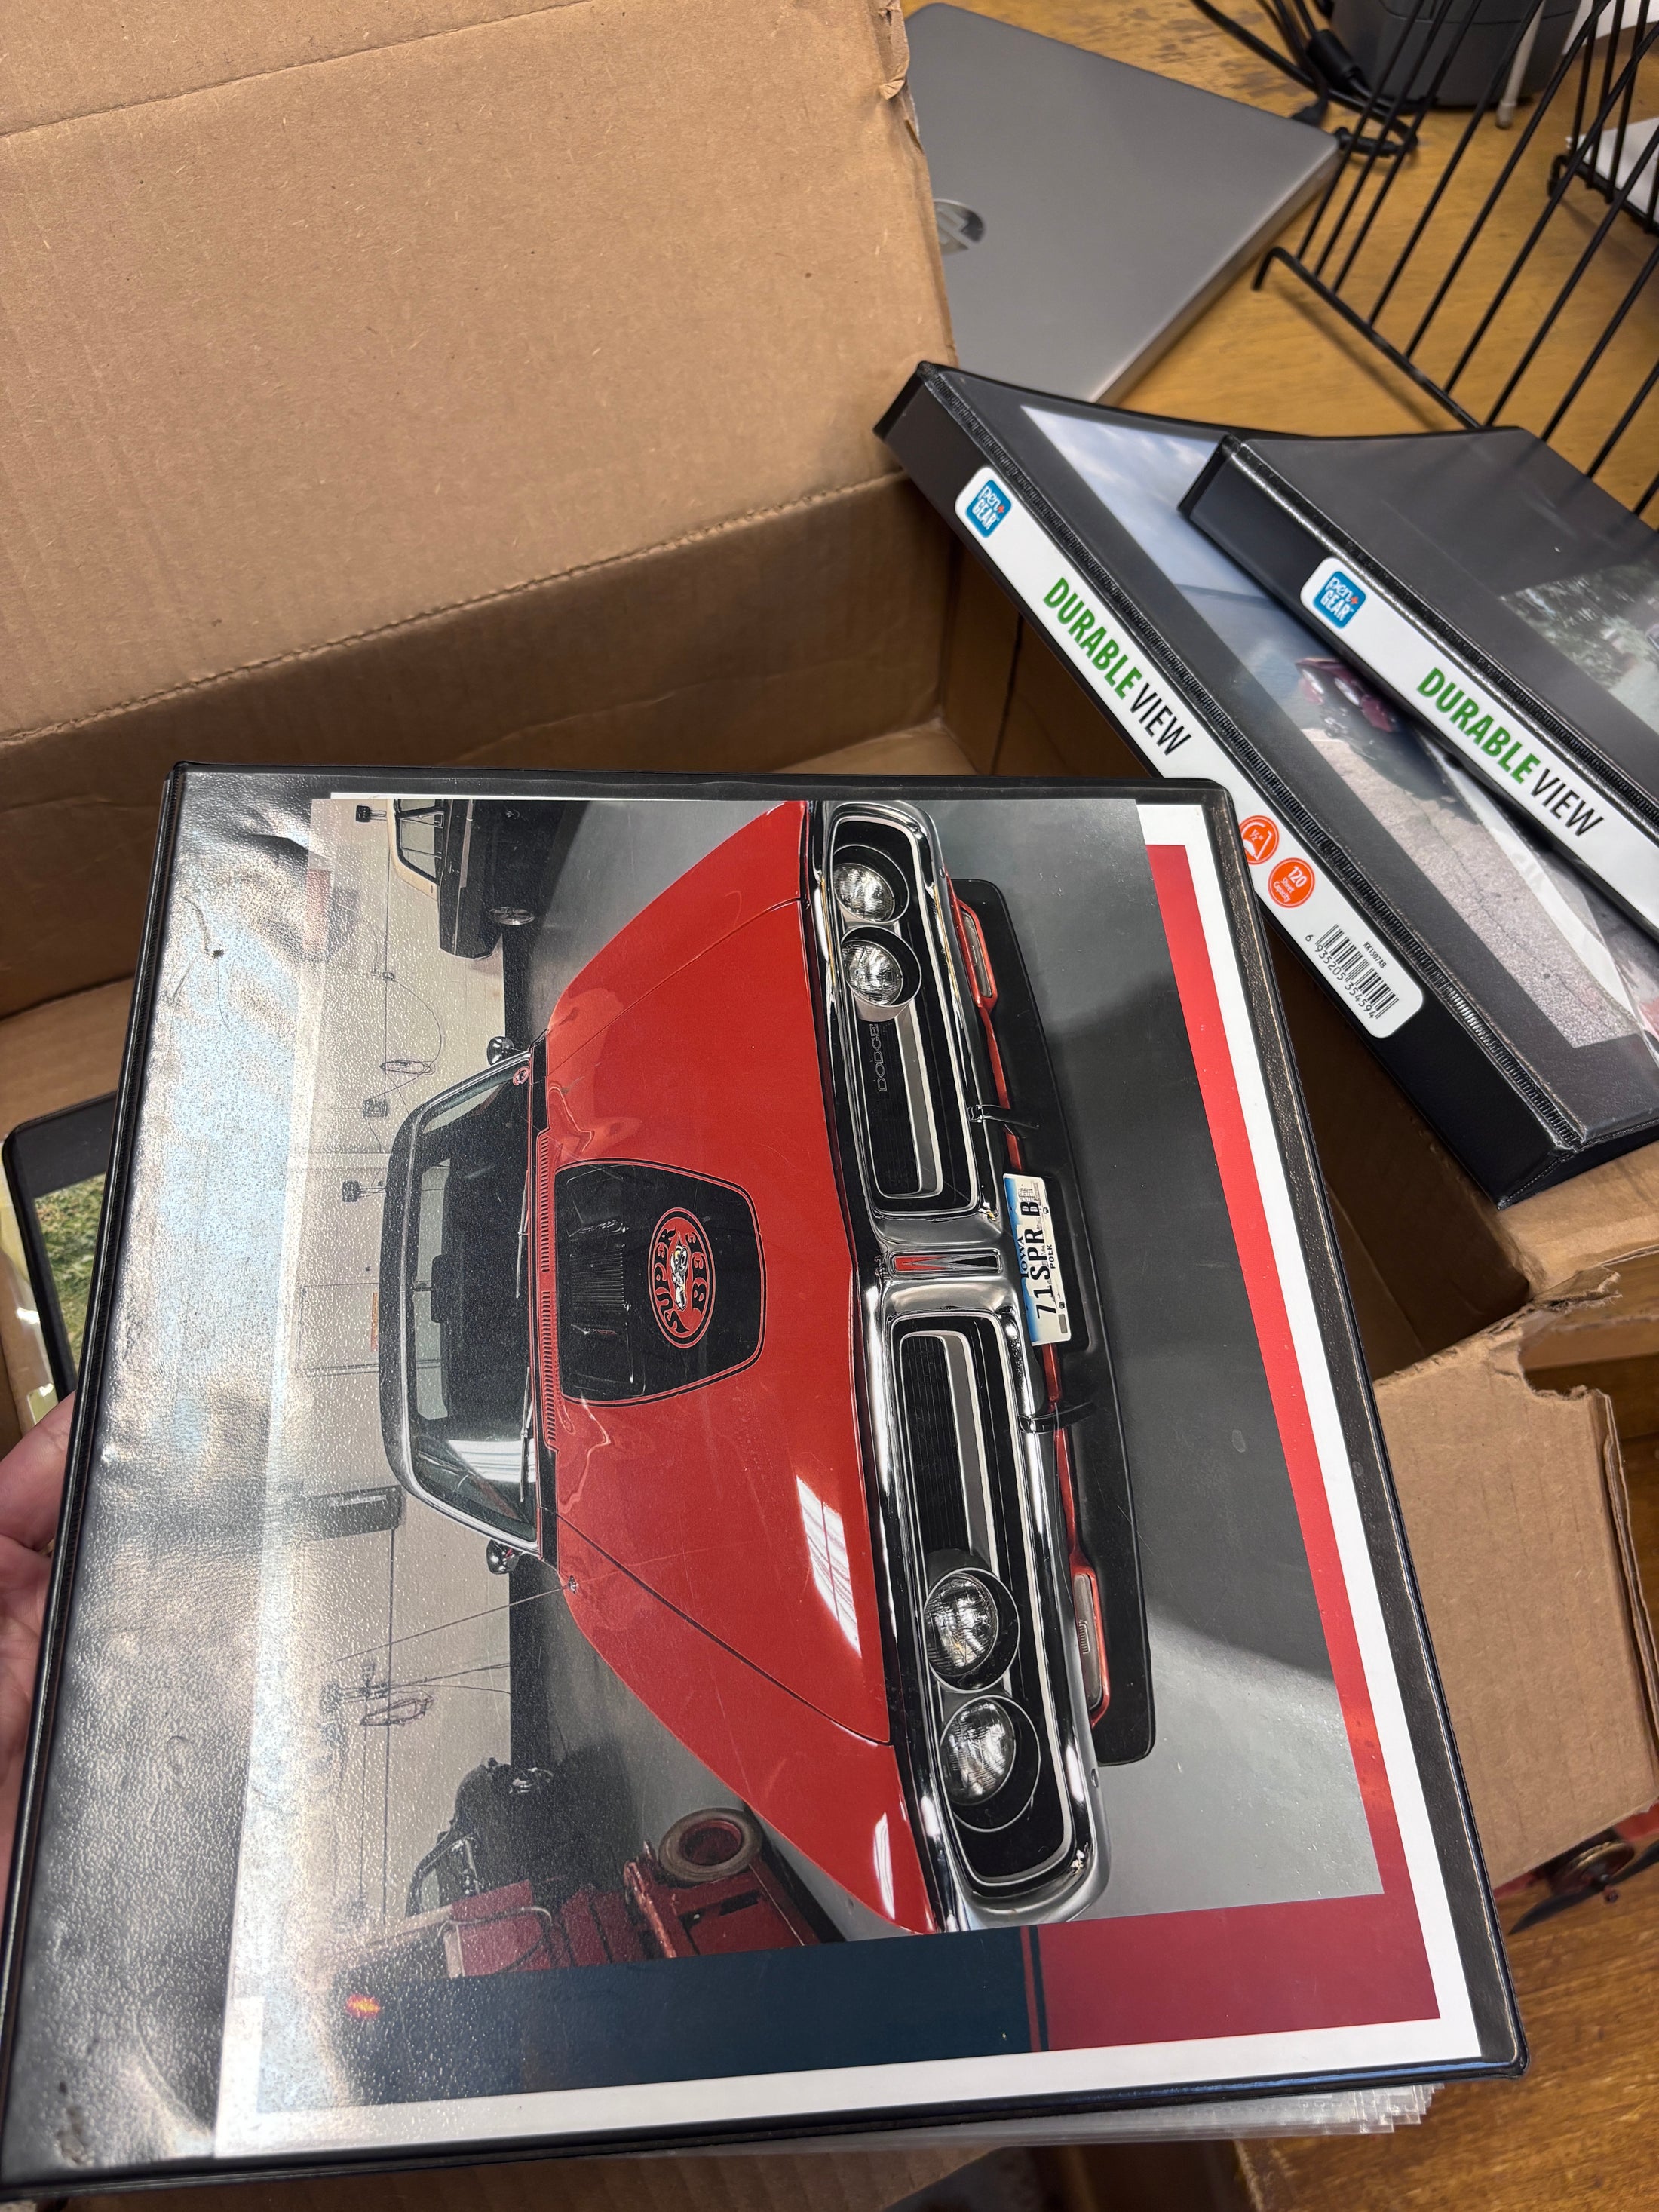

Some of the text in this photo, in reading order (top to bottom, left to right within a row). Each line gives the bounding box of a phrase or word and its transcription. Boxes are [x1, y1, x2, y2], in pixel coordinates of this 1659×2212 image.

[1042, 577, 1192, 756] DURABLE VIEW
[1416, 667, 1605, 837] DURABLE VIEW
[1288, 865, 1308, 888] 120
[869, 1023, 888, 1091] DODGE
[1020, 1201, 1041, 1216] B
[654, 1227, 690, 1333] SUPER
[685, 1232, 707, 1315] BEE
